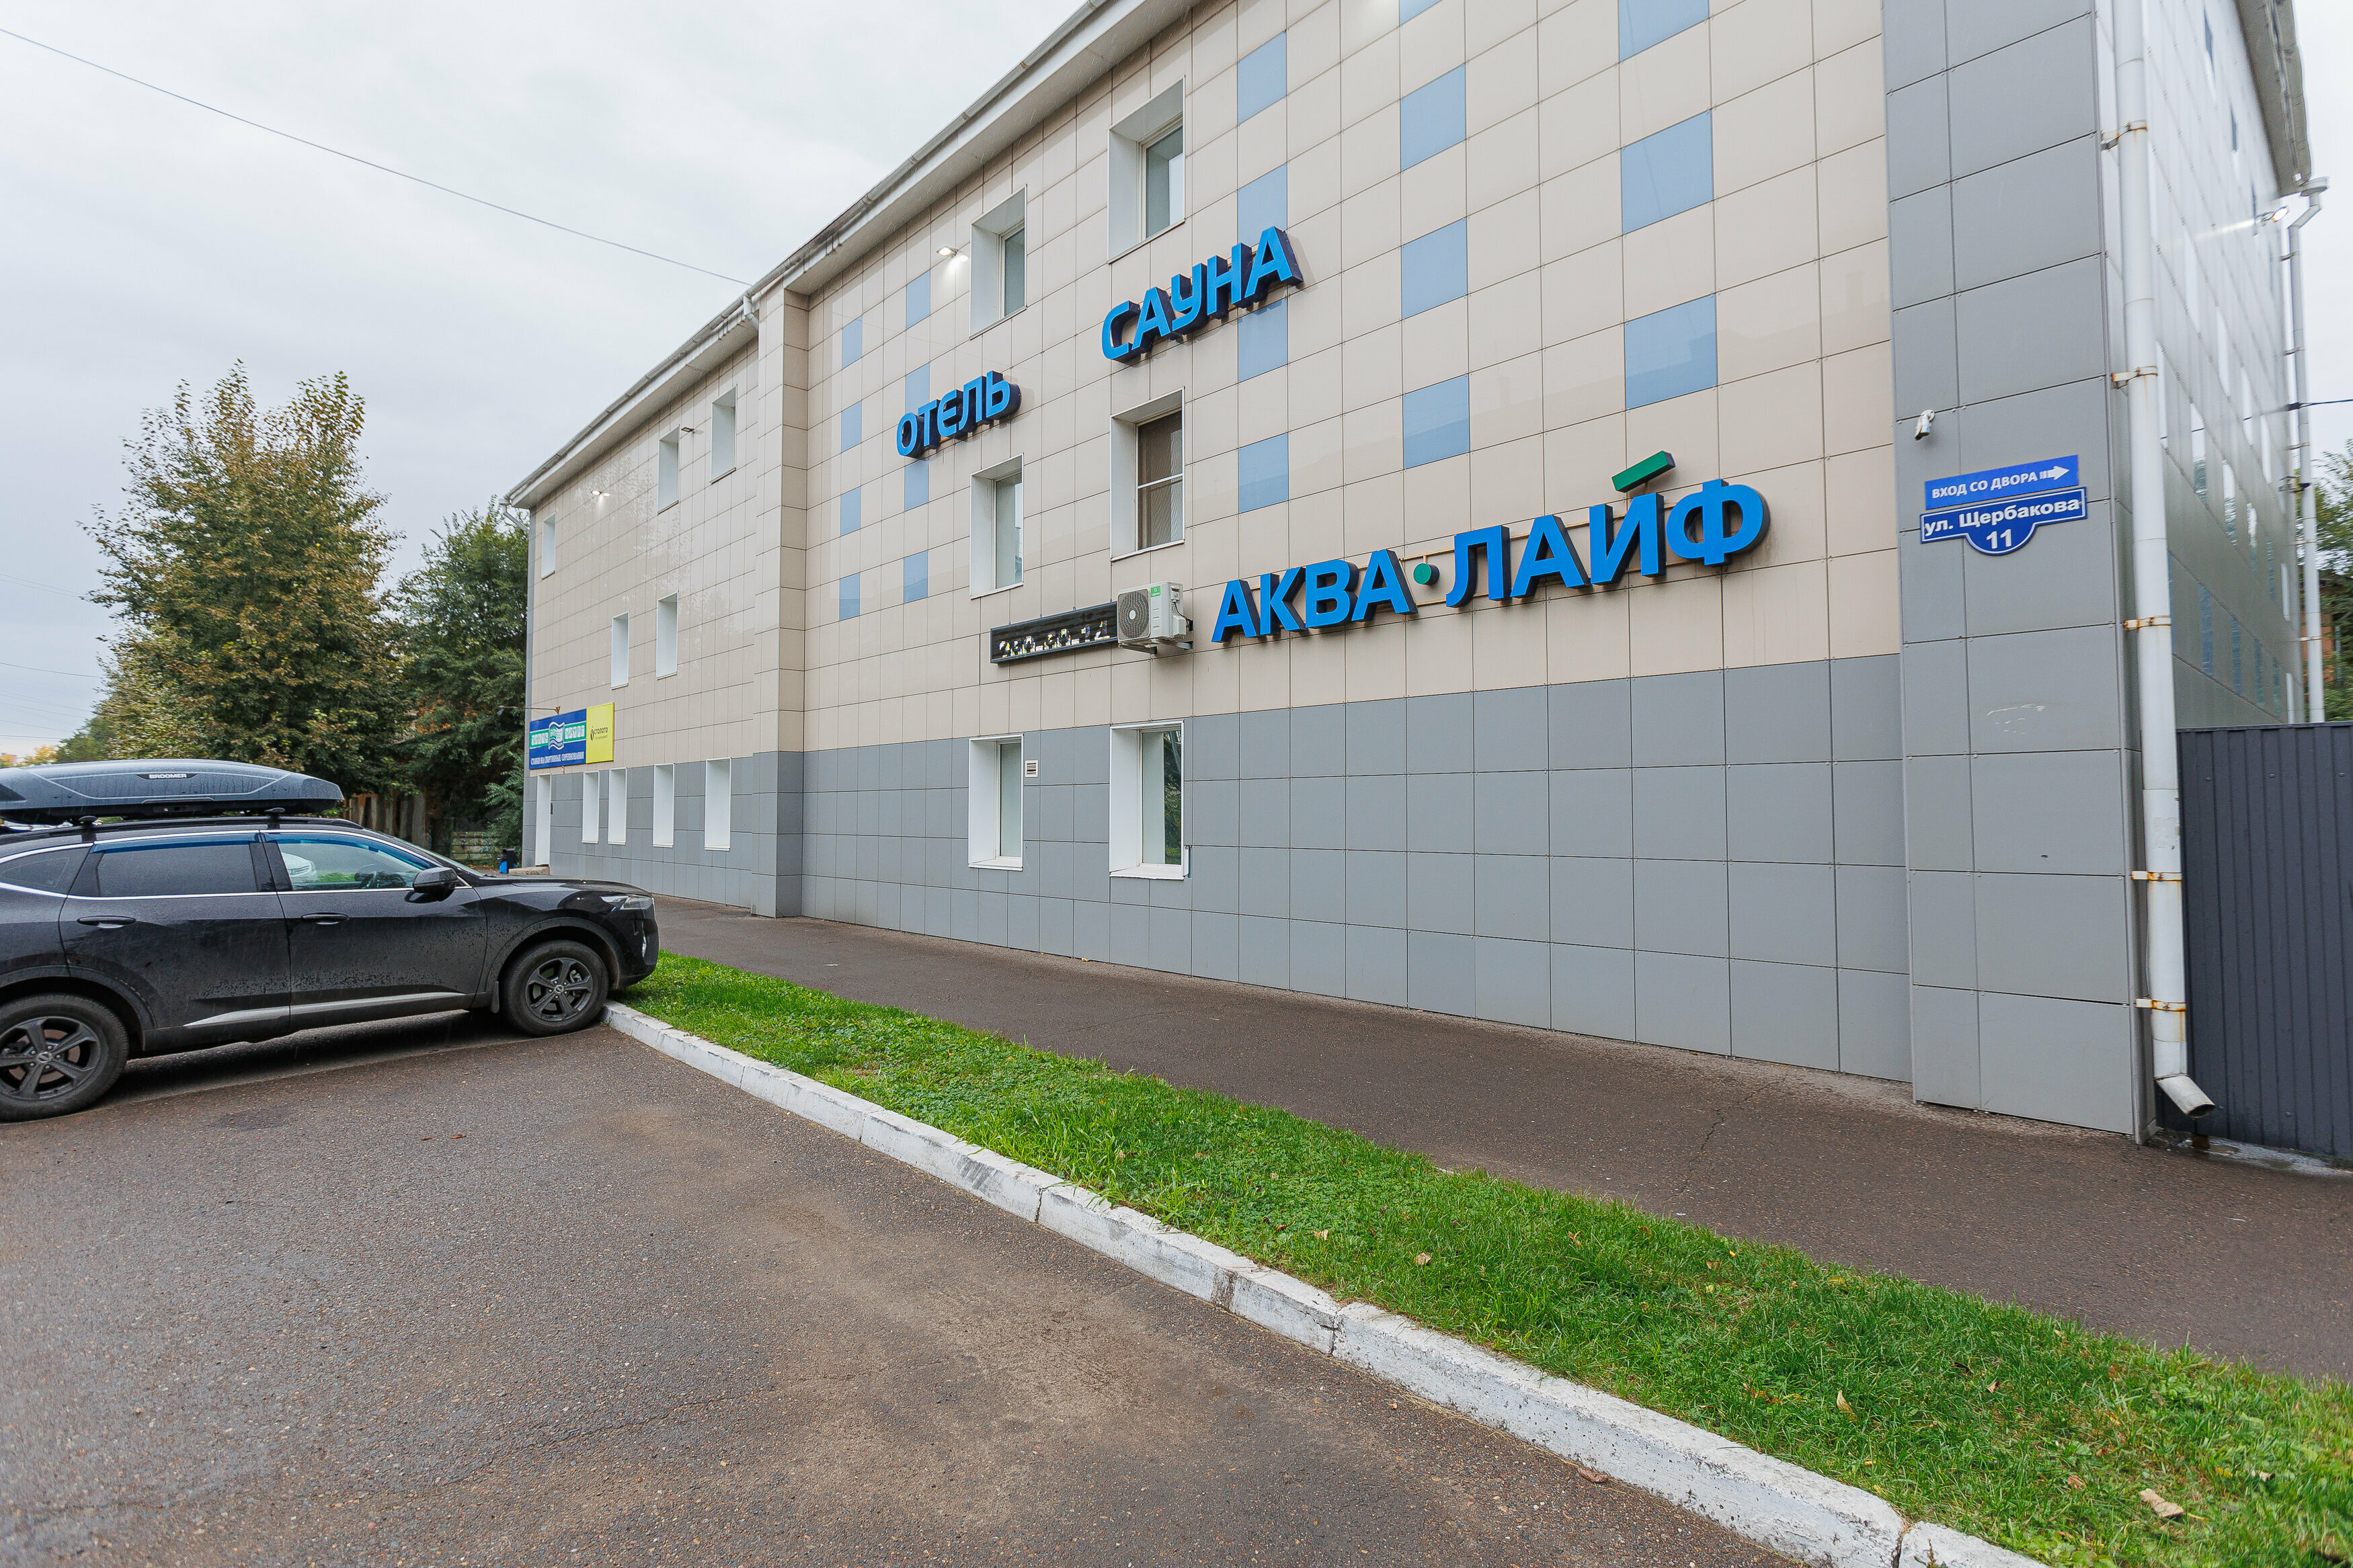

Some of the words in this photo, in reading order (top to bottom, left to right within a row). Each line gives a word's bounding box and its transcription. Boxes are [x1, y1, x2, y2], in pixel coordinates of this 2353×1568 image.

[1102, 226, 1299, 362] САУНА
[897, 370, 1016, 458] ОТЕЛЬ
[1931, 483, 1968, 499] ВХОД
[1968, 480, 1989, 493] СО
[1990, 471, 2038, 491] ДВОРА
[1211, 548, 1413, 643] АКВА
[1445, 450, 1767, 608] ЛАЙФ
[1924, 520, 1954, 537] ул.
[1958, 499, 2081, 528] Щербакова
[1985, 528, 2012, 549] 11
